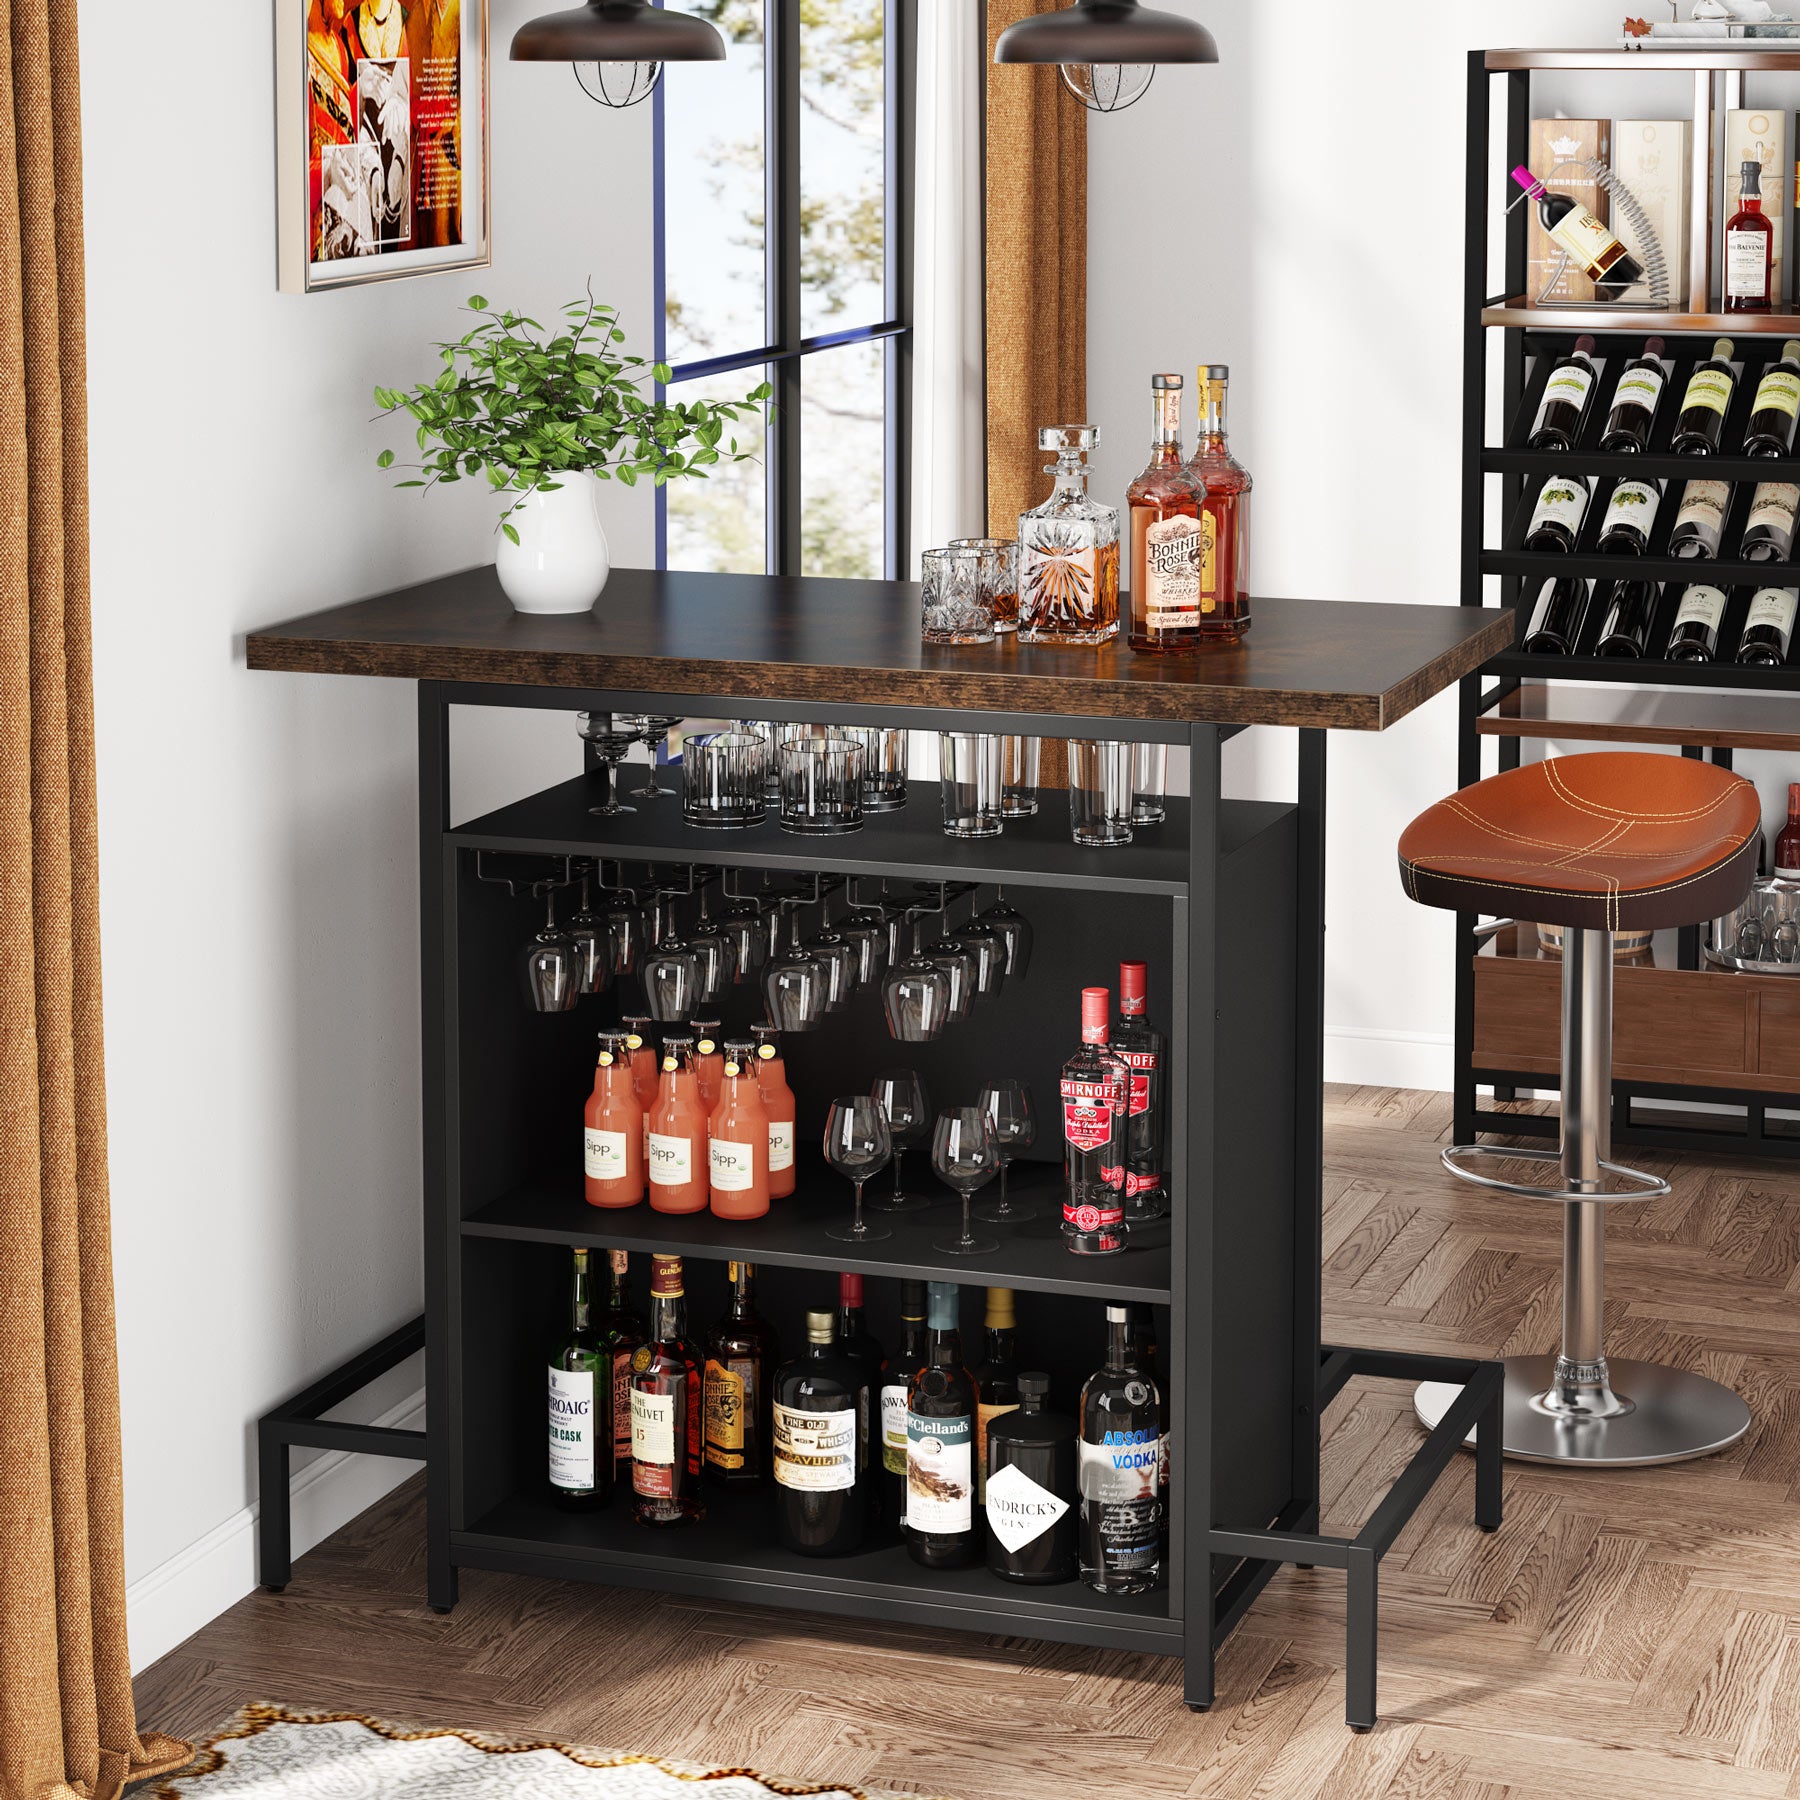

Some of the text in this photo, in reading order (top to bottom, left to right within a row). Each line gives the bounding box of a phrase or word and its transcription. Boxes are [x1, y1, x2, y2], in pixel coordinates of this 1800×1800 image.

[1168, 395, 1179, 425] Spiced Apple
[1156, 551, 1188, 573] ROSE
[1162, 587, 1198, 595] WHISKEY
[1158, 615, 1181, 625] Spiced
[1061, 1082, 1118, 1097] SMIRNOFF
[586, 1138, 610, 1156] Sipp
[651, 1144, 675, 1162] Sipp
[712, 1149, 737, 1168] Sipp
[635, 1396, 646, 1407] THE
[786, 1417, 825, 1429] FINE OLD
[560, 1430, 582, 1442] CASK
[637, 1428, 645, 1441] 15
[819, 1429, 853, 1448] WHISKY
[1113, 1450, 1157, 1470] VODKA
[989, 1495, 1057, 1515] ENDRICK'S
[1002, 1519, 1024, 1528] GIN
